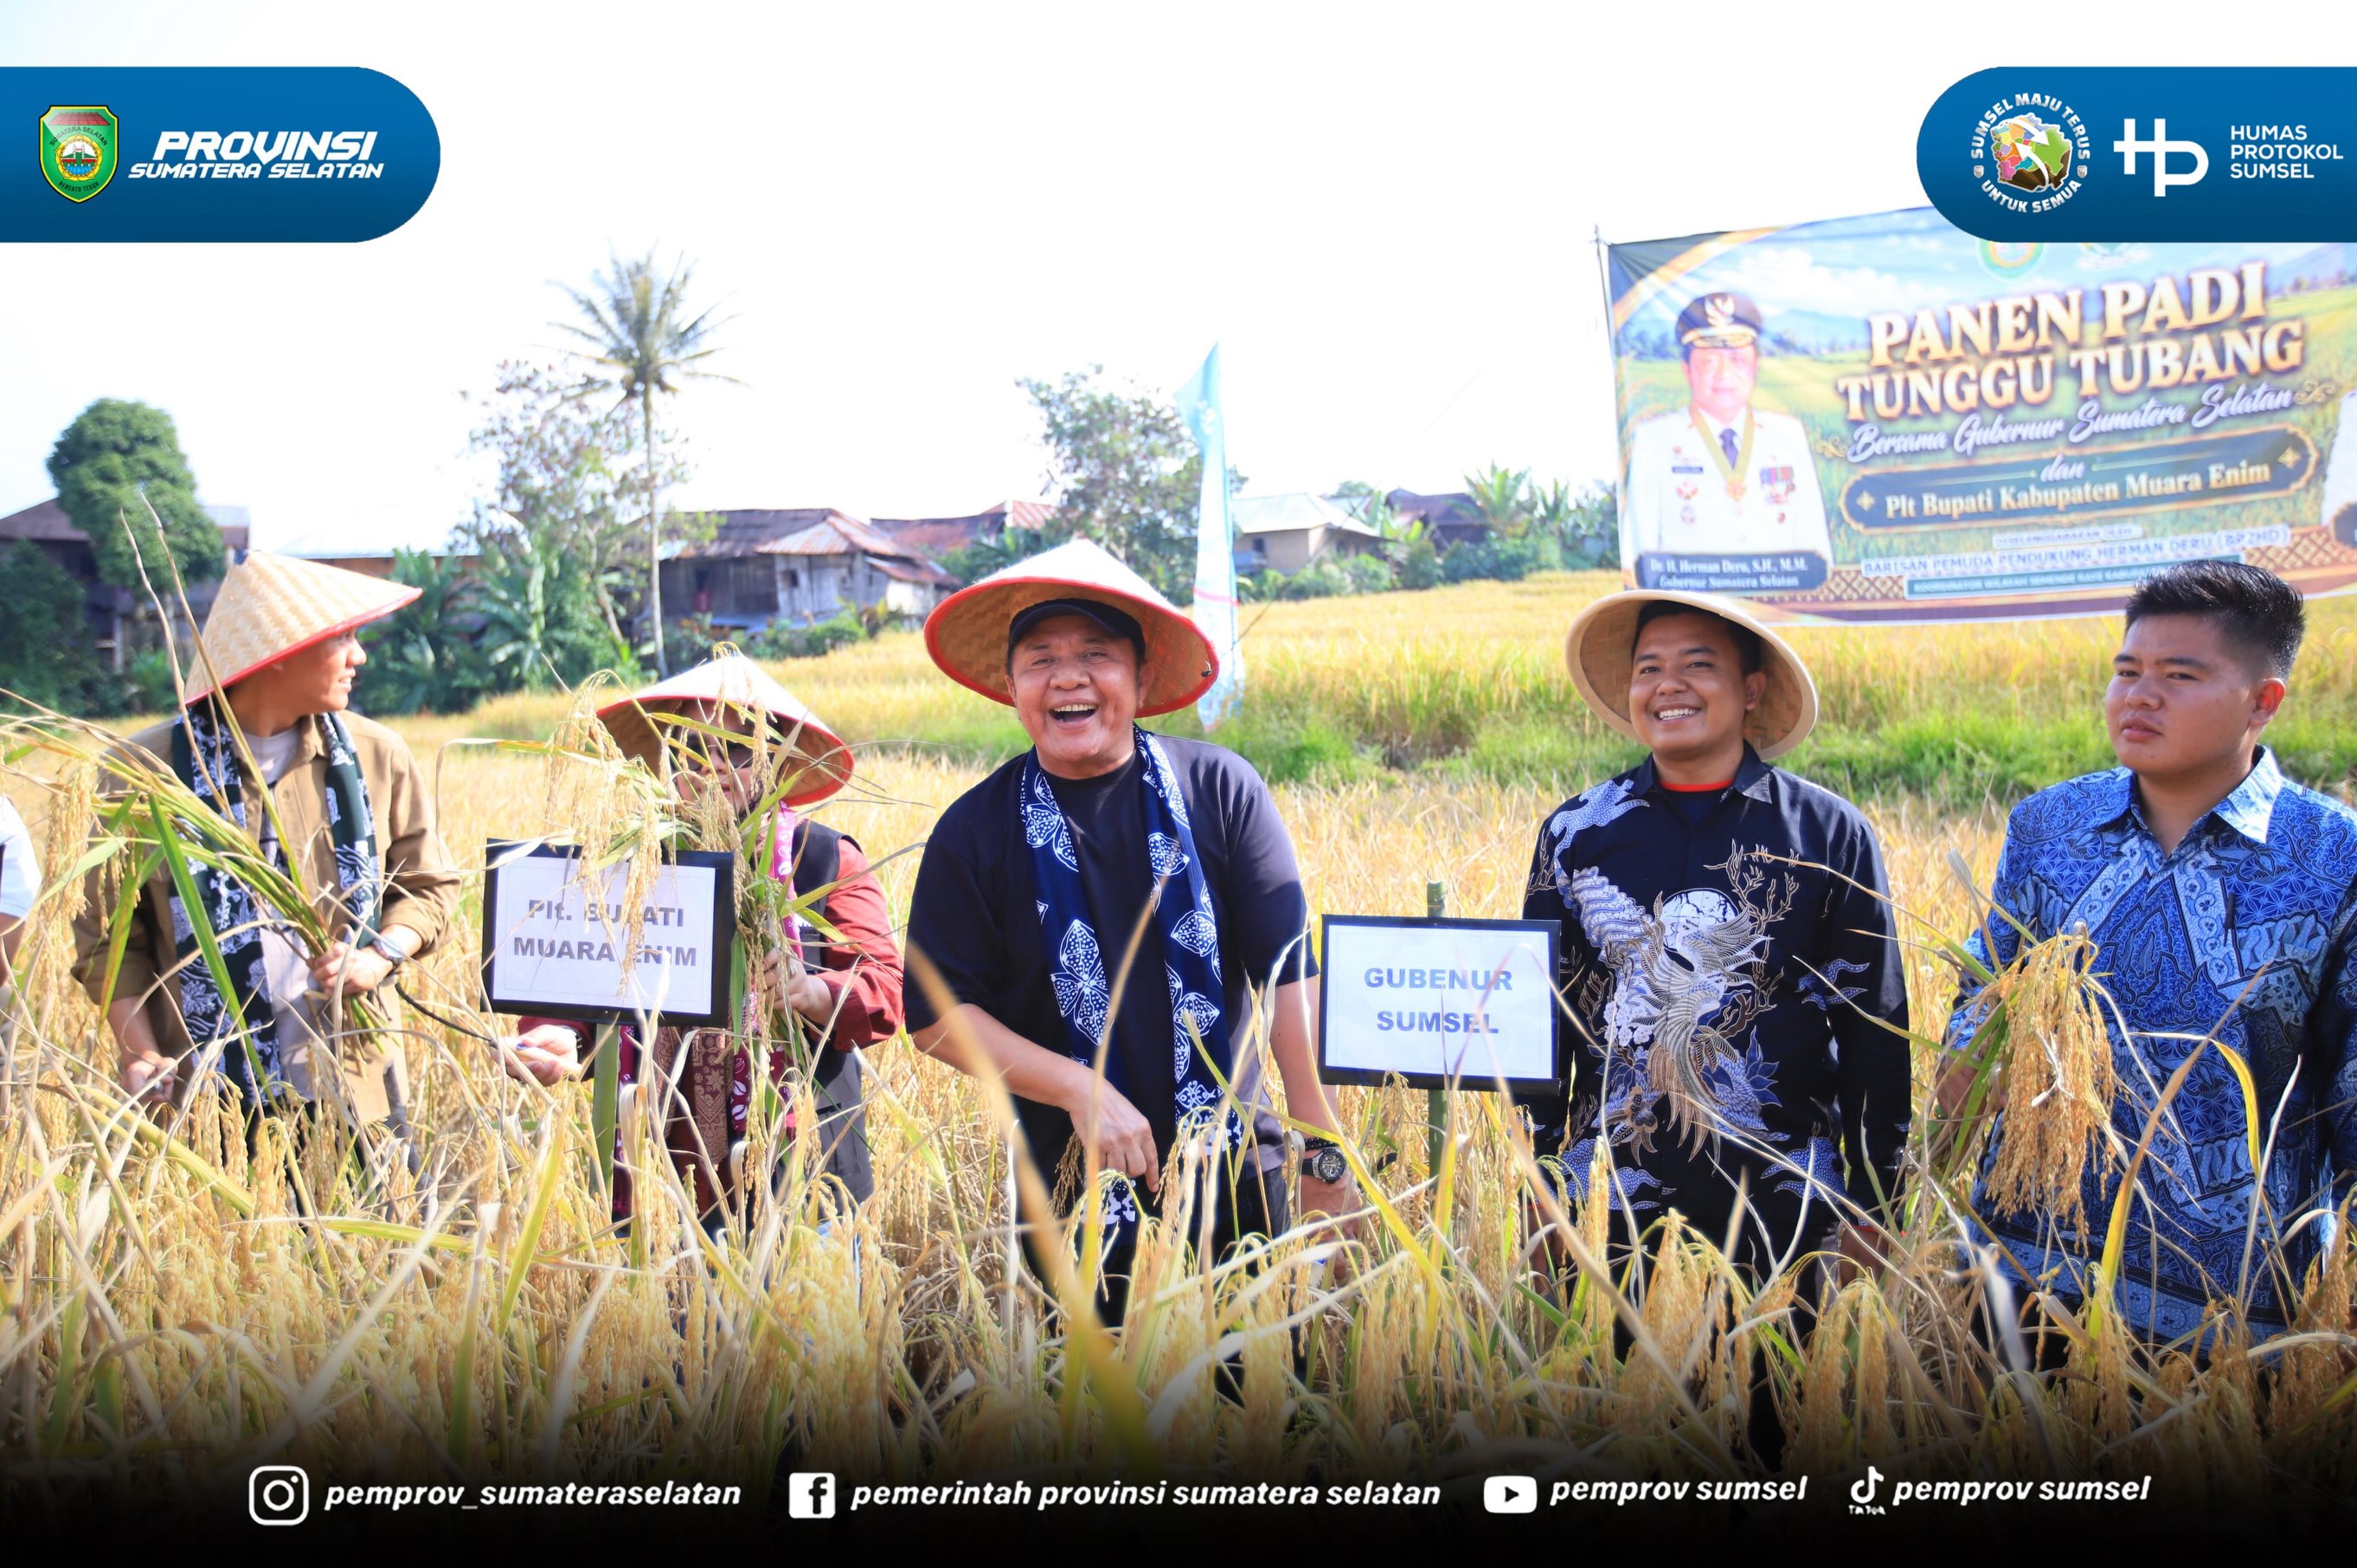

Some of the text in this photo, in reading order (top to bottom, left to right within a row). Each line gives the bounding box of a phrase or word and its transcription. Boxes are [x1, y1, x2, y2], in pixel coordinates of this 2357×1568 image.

[1869, 261, 2267, 367] PANEN PADI
[1836, 319, 2304, 421] TUNGGU TUBANG
[1846, 382, 2293, 463] Bersama Gubernur Sumatera Selatan
[2039, 453, 2086, 483] dan
[1885, 459, 2271, 520] Plt Bupati Kabupaten Muara Enim
[1679, 559, 1720, 574] Herman
[1863, 559, 1928, 575] BARISAN
[1933, 554, 1994, 570] PEMUDA
[1999, 547, 2092, 565] PENDUKUNG
[2097, 542, 2163, 558] HERMAN
[2170, 537, 2212, 553] DERU
[1709, 574, 1758, 588] Sumatera
[1759, 573, 1800, 588] Selatan
[529, 898, 684, 927] Plt. BUATI
[513, 936, 615, 962] MUARA
[1364, 967, 1513, 991] GUBENUR
[1377, 1010, 1500, 1034] SUMSEL
